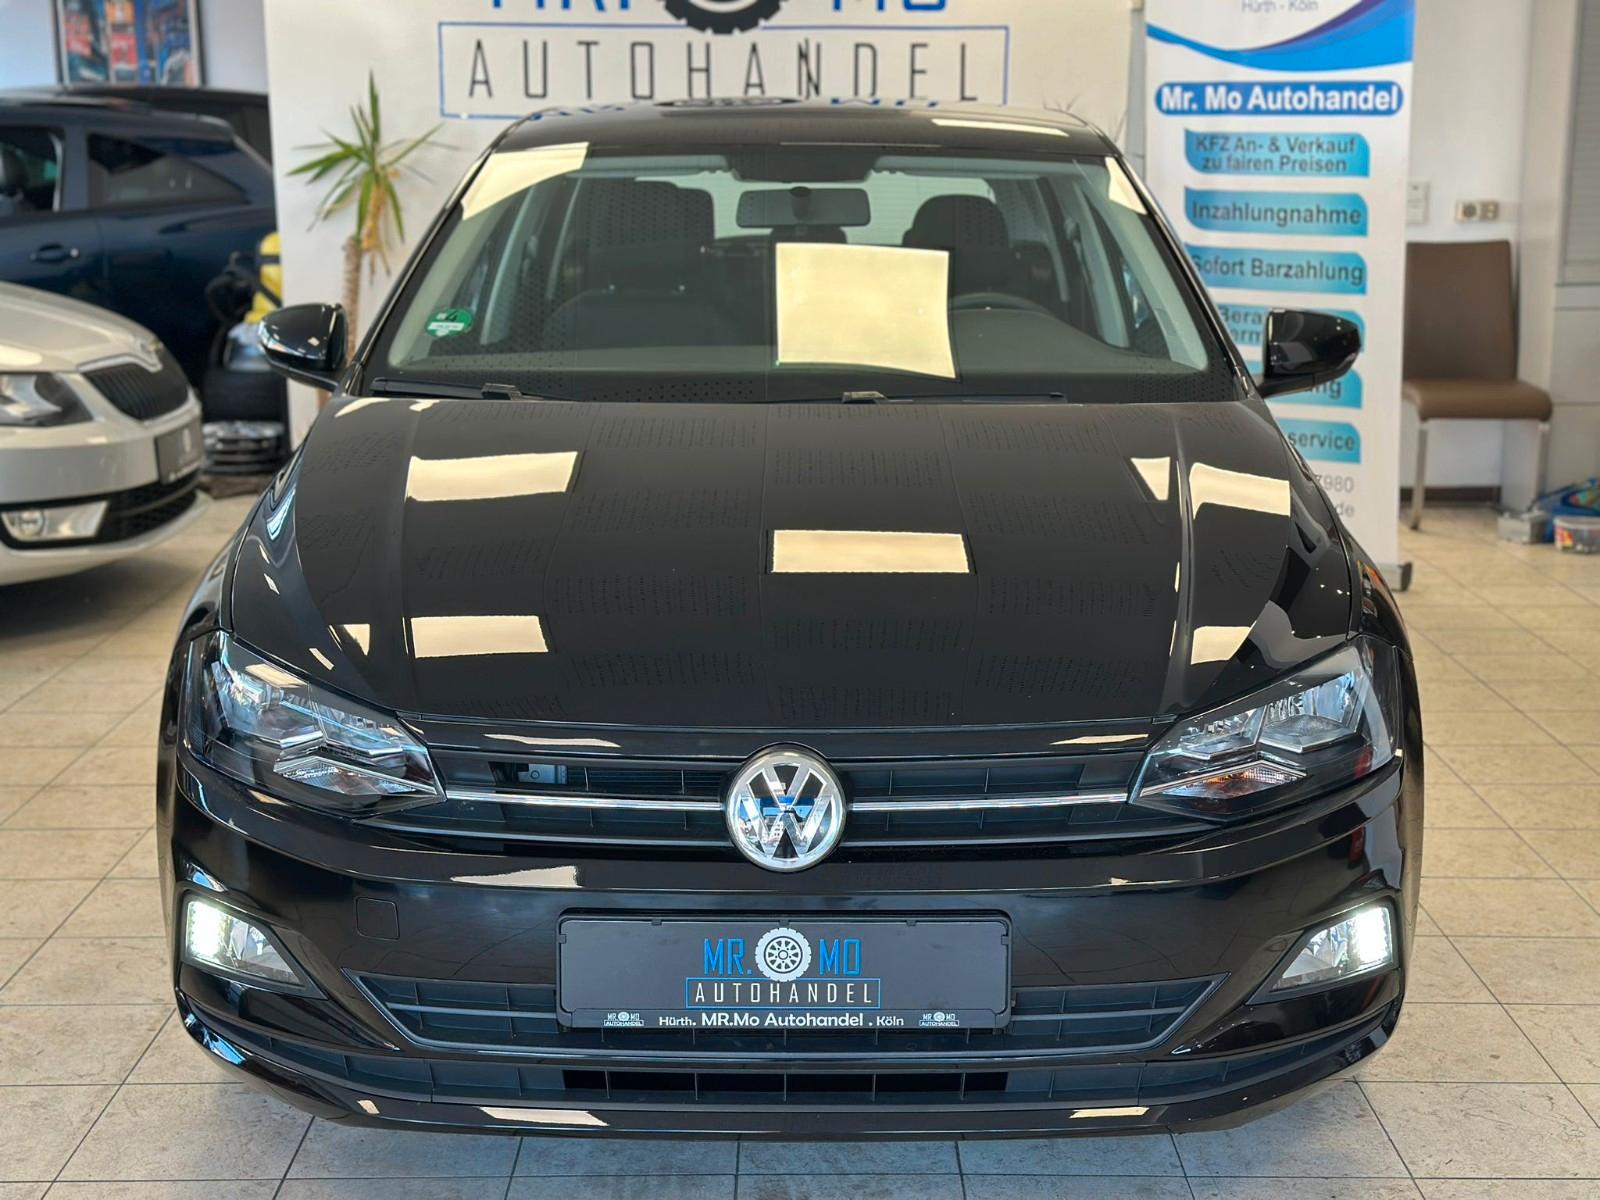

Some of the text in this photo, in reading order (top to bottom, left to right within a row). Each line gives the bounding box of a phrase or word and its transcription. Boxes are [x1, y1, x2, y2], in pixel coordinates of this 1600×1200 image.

[468, 39, 978, 101] AUTOHANDEL
[1160, 85, 1399, 111] Mr. Mo Autohandel
[1195, 137, 1357, 154] KFZ An- & Verkauf
[1202, 155, 1347, 172] zu fairen Preisen
[1191, 202, 1362, 227] Inzahlungnahme
[1191, 255, 1364, 286] Sofort Barzahlung
[703, 938, 862, 976] MR. MO
[695, 982, 873, 1003] AUTOHANDEL
[764, 1012, 864, 1027] Autohandel
[876, 1015, 905, 1026] Köln
